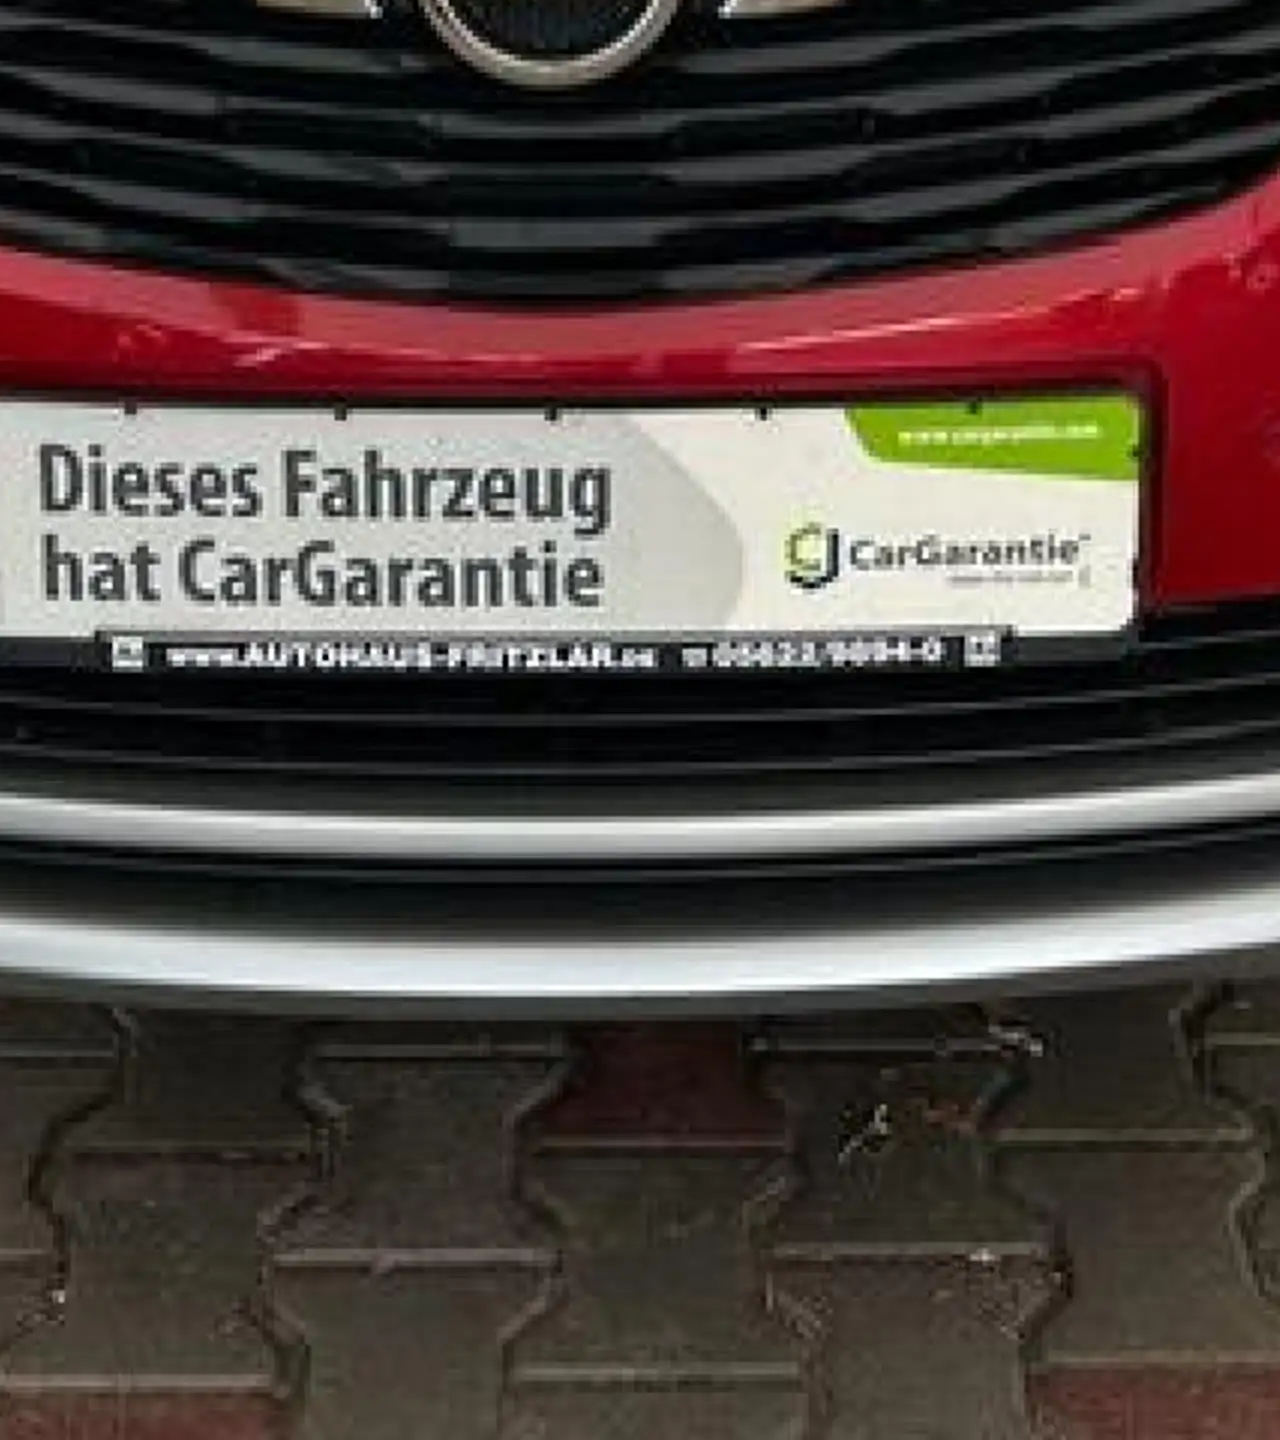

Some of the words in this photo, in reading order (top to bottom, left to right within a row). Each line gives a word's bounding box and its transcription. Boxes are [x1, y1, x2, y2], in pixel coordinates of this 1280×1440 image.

[39, 443, 263, 517] Dieses
[282, 448, 612, 539] Fahrzeug
[40, 533, 162, 602] hat
[179, 538, 605, 608] CarGarantie
[848, 531, 1084, 571] CarGarantie
